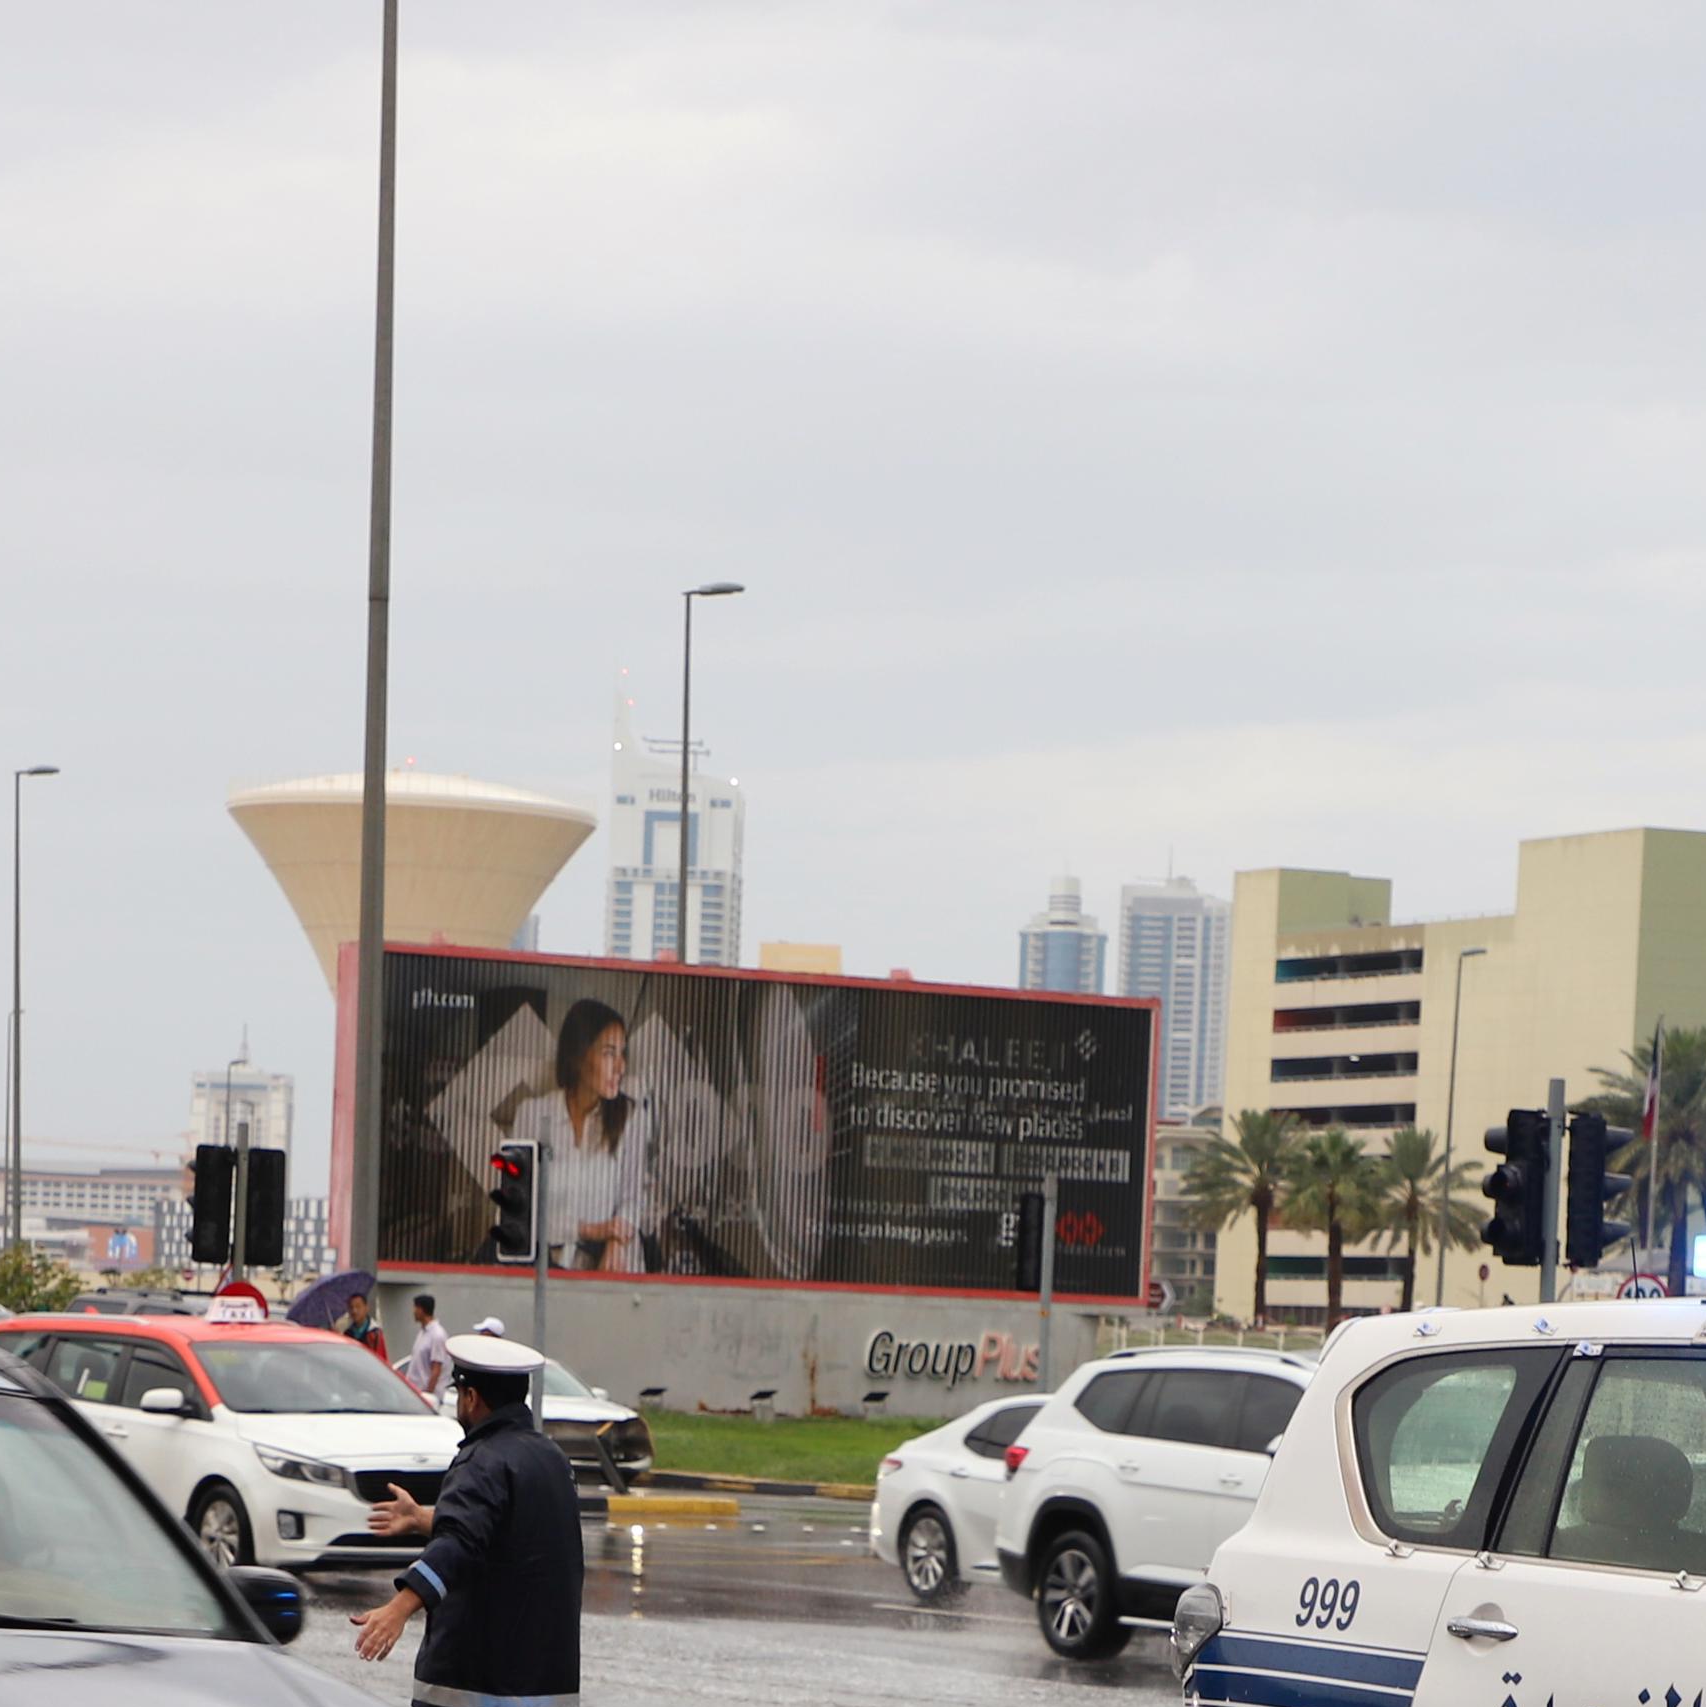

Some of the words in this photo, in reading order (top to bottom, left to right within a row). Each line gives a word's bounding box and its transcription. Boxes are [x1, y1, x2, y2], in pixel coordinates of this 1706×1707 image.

[851, 1061, 937, 1092] Because
[944, 1073, 983, 1100] you
[989, 1074, 1086, 1103] promised
[849, 1103, 871, 1127] to
[875, 1102, 965, 1133] discover
[1295, 1577, 1360, 1631] 999
